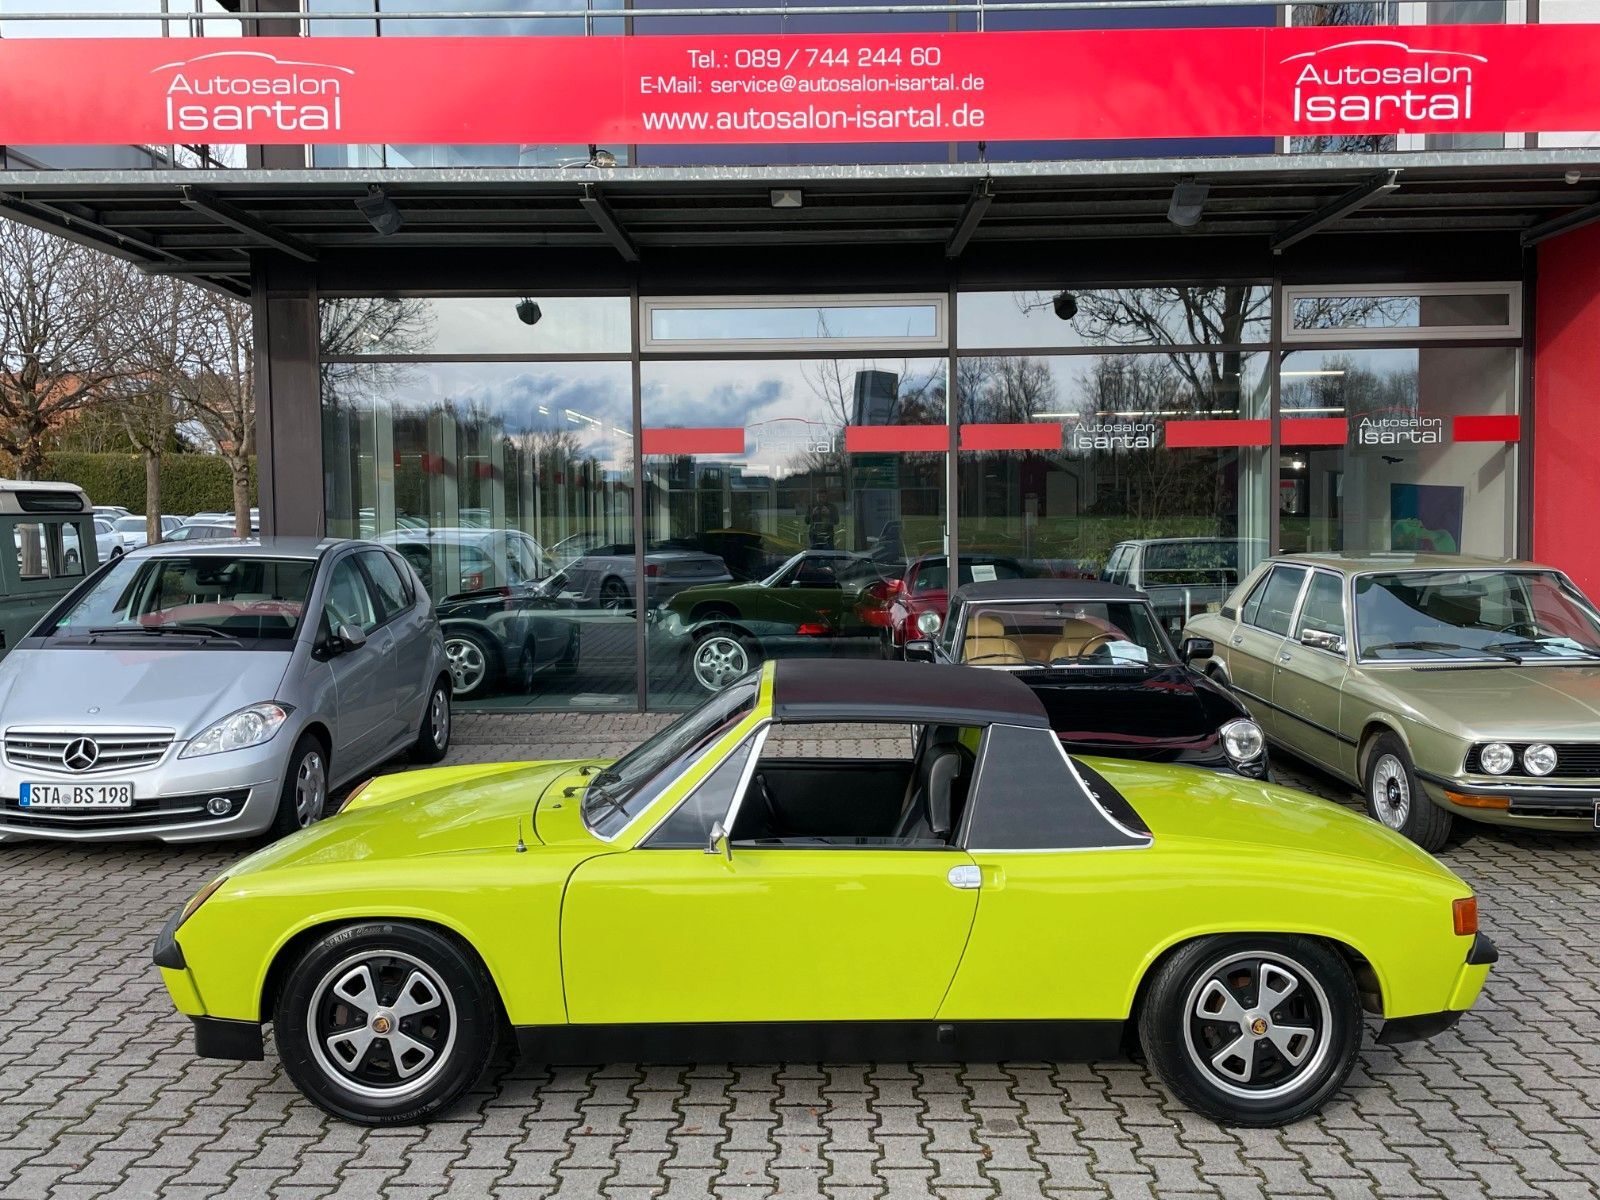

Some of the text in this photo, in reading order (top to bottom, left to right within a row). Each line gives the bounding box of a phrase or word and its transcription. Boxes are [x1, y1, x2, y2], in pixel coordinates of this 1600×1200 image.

[686, 46, 941, 70] Tel.: 089 / 744 244 60
[640, 73, 985, 94] E-Mail: service@autosalon-isartal.de
[1295, 61, 1472, 85] Autosalon
[167, 73, 340, 95] Autosalon
[166, 96, 341, 131] Isartal
[1293, 85, 1472, 122] Isartal
[642, 103, 985, 130] www.autosalon-isartal.de
[1073, 421, 1155, 433] Autosalon
[1359, 416, 1442, 428] Autosalon
[1073, 432, 1155, 449] Isartal
[1358, 427, 1442, 445] Isartal
[31, 786, 61, 804] STA
[73, 786, 94, 804] BS
[98, 786, 129, 803] 198
